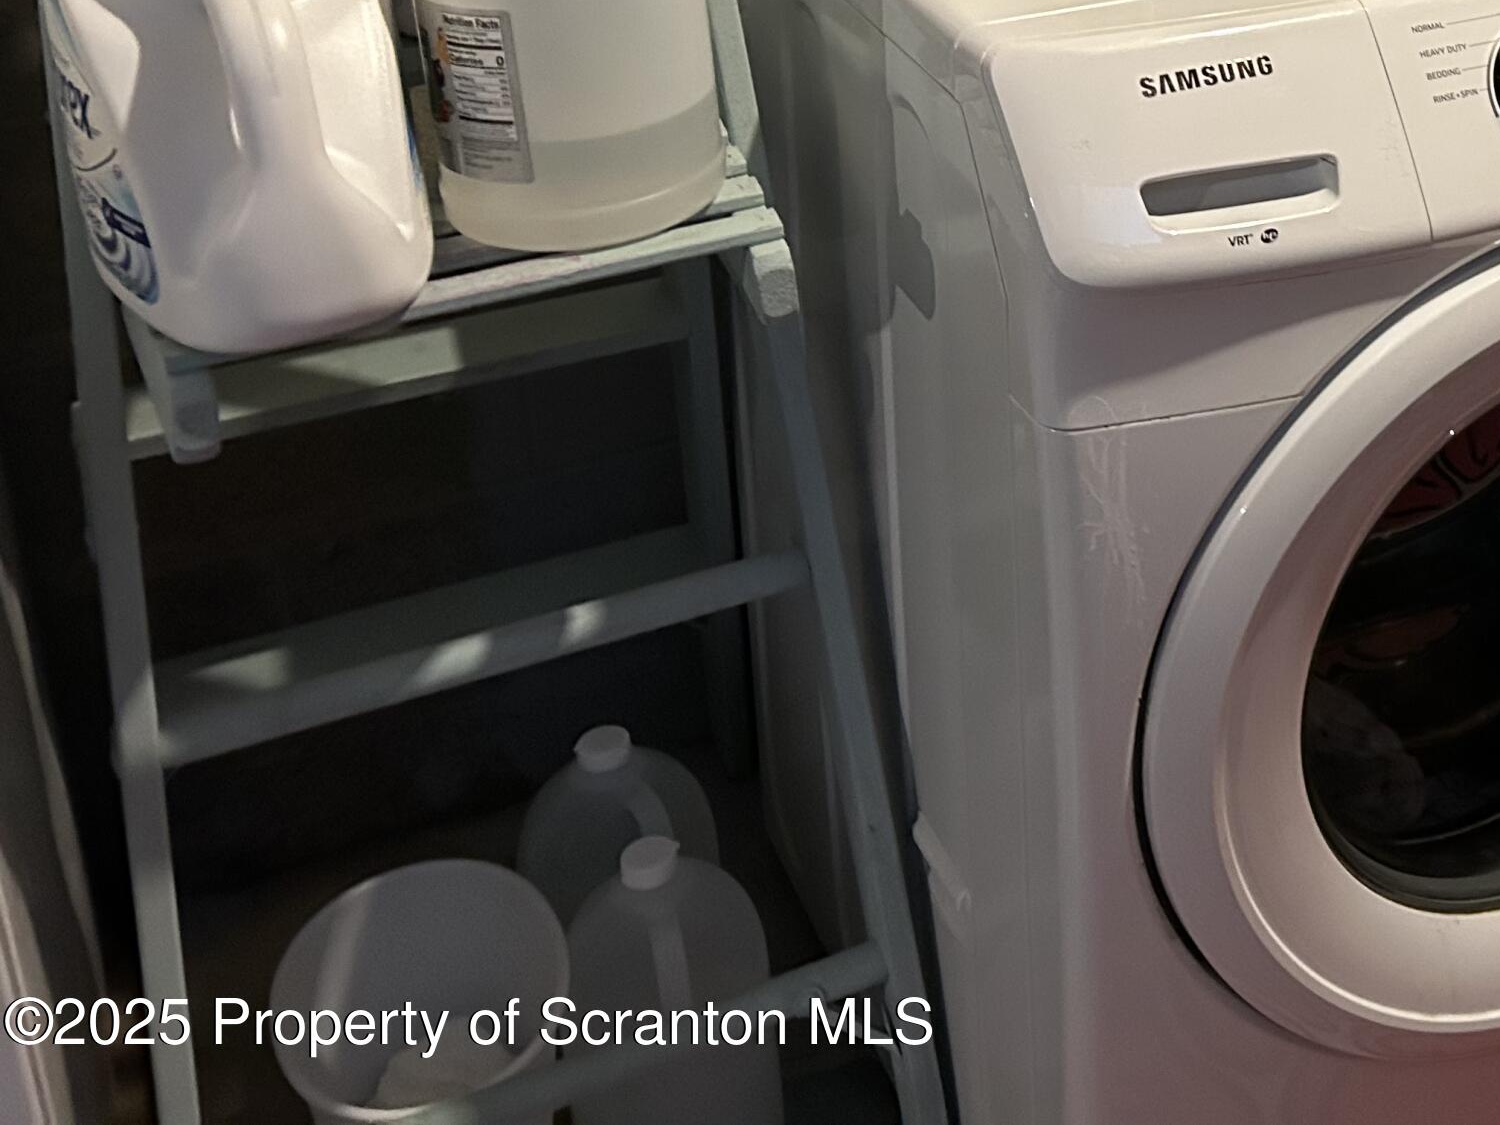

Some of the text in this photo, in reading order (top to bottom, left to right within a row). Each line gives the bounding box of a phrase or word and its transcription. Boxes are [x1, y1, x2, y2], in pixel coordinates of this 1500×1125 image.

[1410, 22, 1445, 34] NORMAL
[1419, 43, 1467, 58] HEAVY DUTY
[495, 56, 505, 67] 0
[1139, 55, 1274, 98] SAMSUNG
[1426, 67, 1462, 81] BEDDING
[1433, 92, 1457, 104] RINSE
[1460, 88, 1479, 99] SPIN
